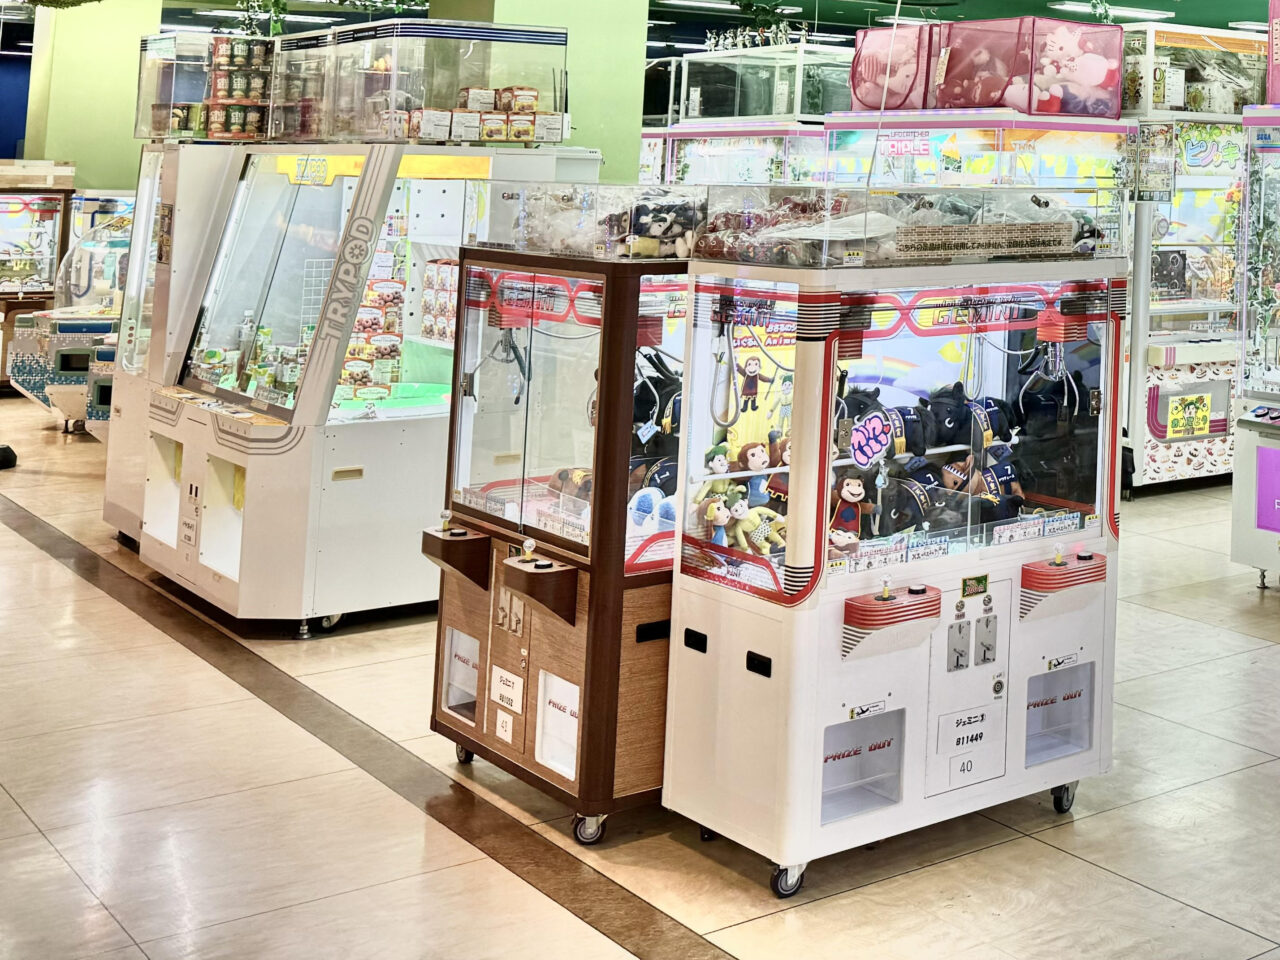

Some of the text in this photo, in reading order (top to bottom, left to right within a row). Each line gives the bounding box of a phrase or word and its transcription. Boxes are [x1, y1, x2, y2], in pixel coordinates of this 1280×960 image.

[877, 135, 930, 156] TRIPLE
[317, 216, 375, 341] TRYPOD
[932, 304, 1019, 326] GEMINI
[1026, 689, 1084, 711] PRIZE OUT
[823, 738, 894, 764] PRIZE OUT
[959, 759, 973, 774] 40
